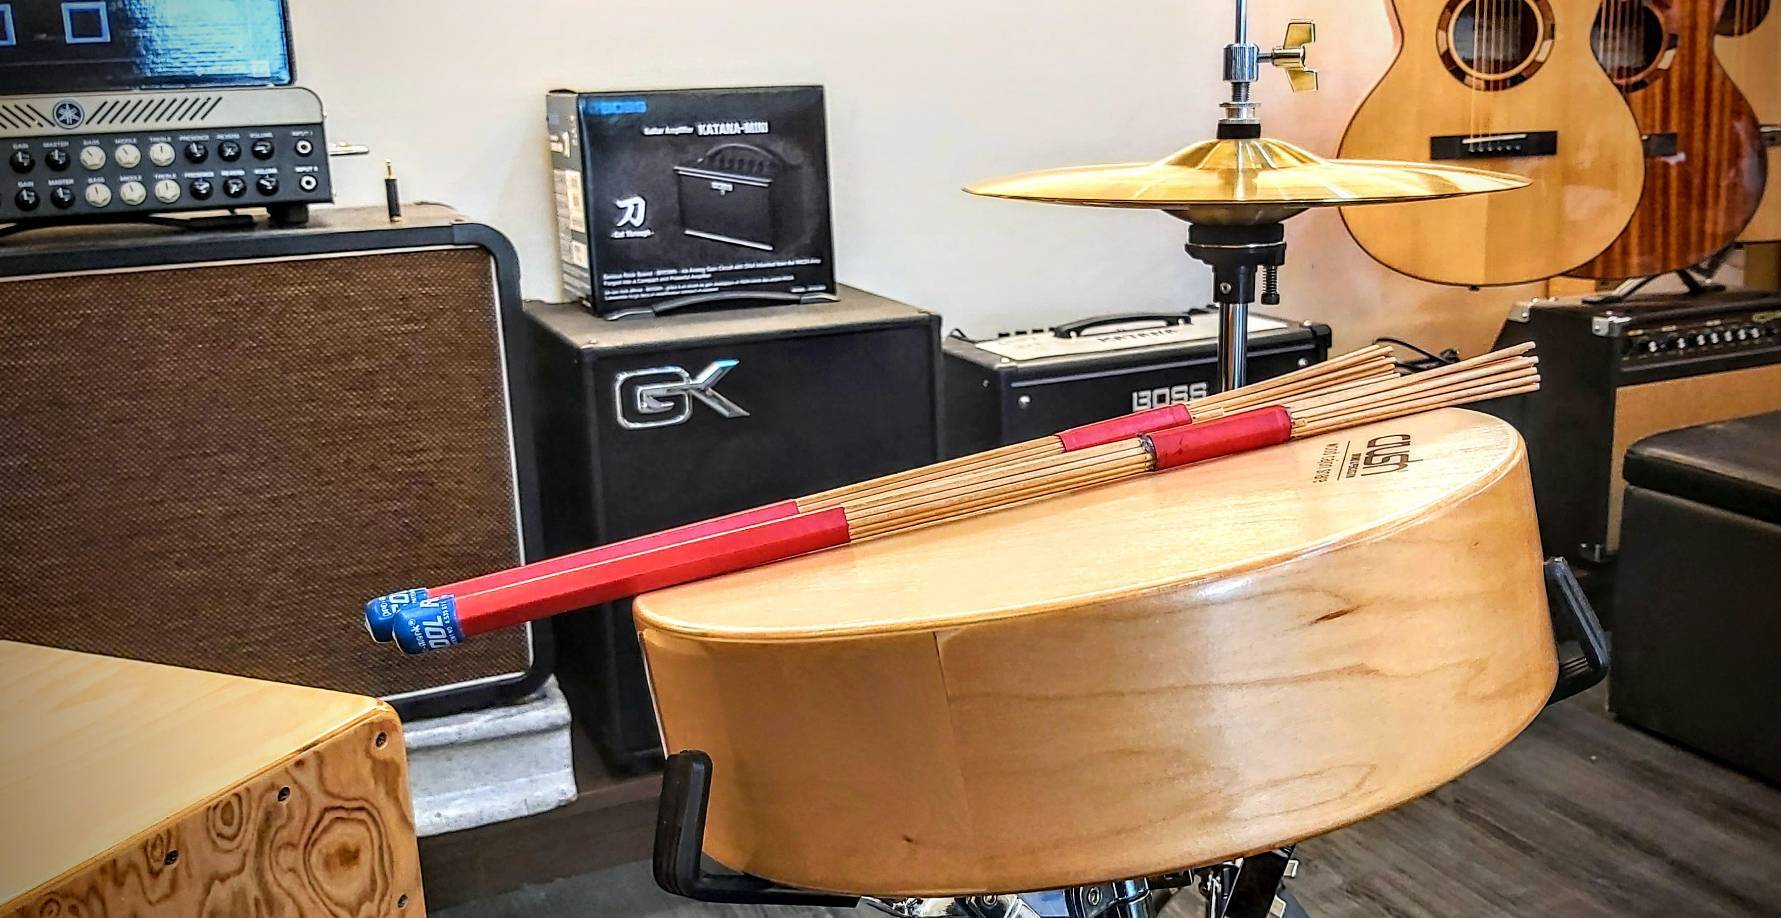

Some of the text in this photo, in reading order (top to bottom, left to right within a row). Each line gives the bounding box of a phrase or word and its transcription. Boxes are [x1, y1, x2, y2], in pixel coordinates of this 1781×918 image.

[698, 121, 769, 136] KATANA-MINI
[48, 178, 74, 186] MASTER
[614, 195, 646, 227] 刀
[1097, 330, 1177, 342] KATANA
[614, 359, 750, 430] GK
[1132, 382, 1208, 412] BOSS
